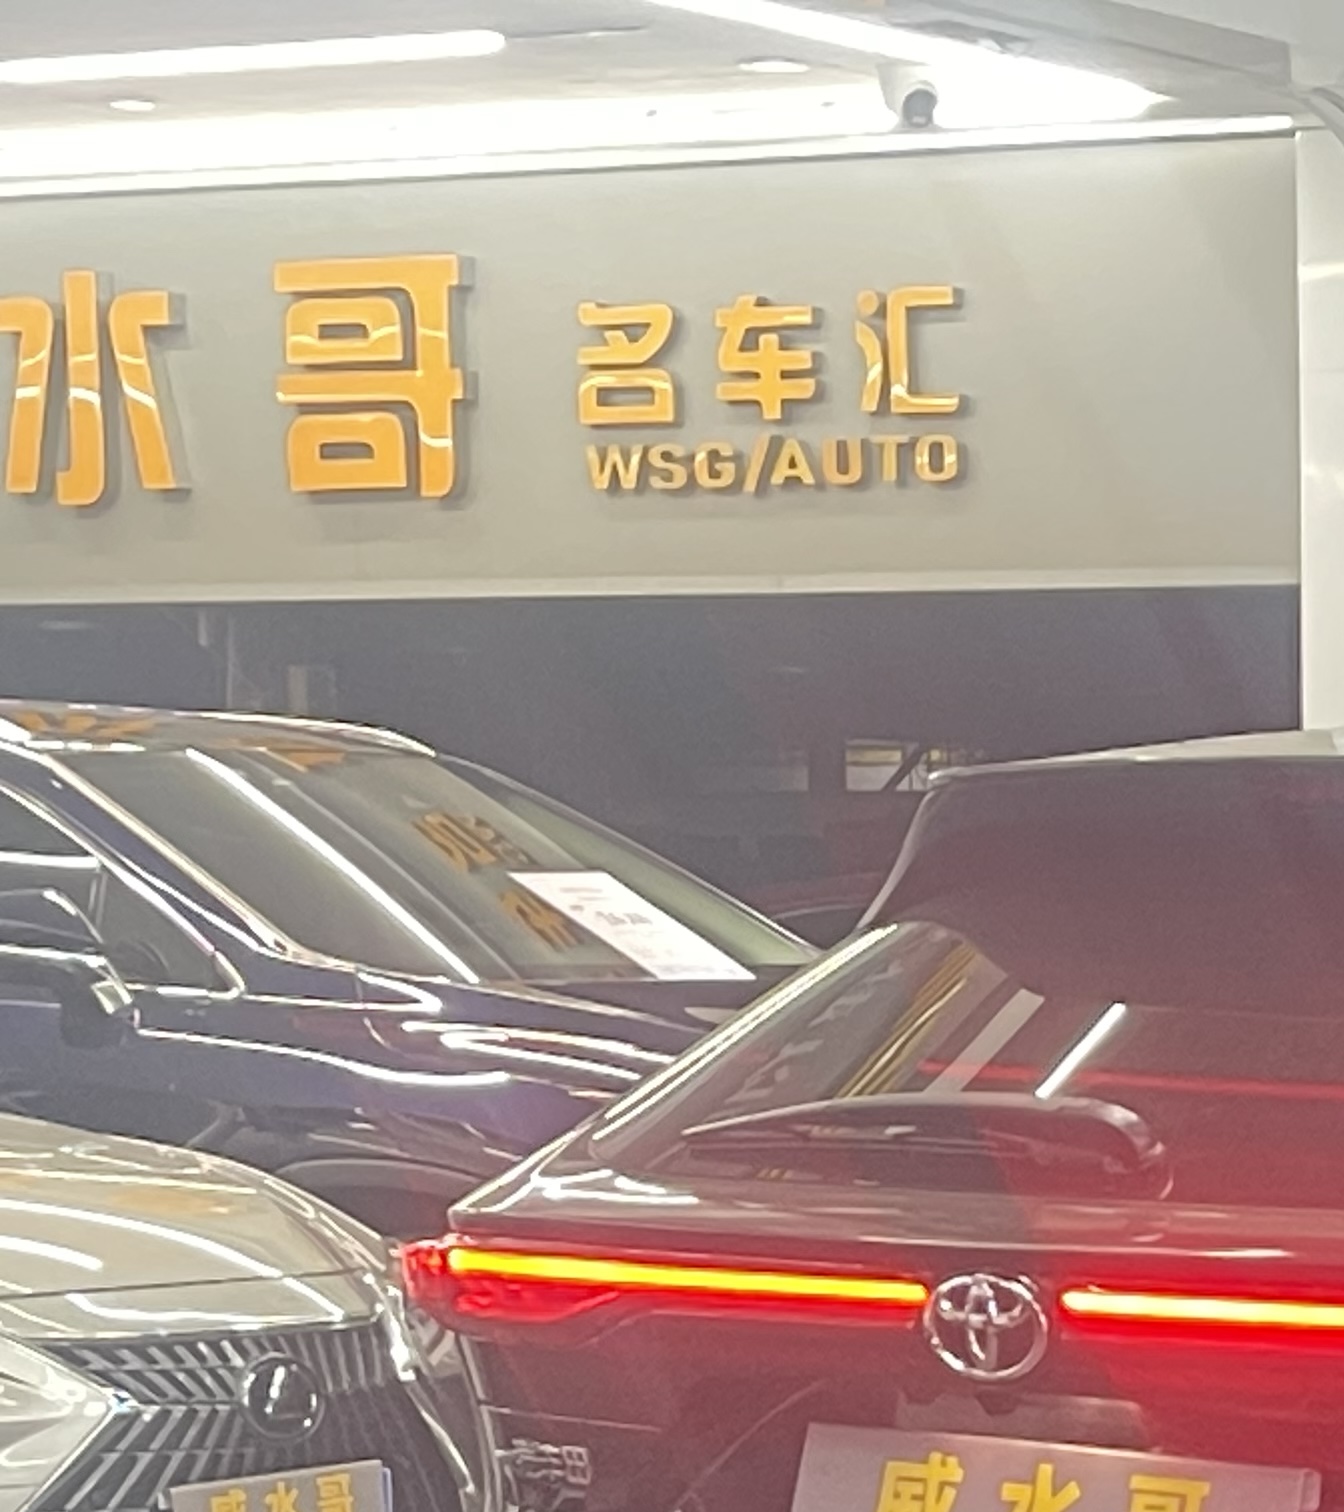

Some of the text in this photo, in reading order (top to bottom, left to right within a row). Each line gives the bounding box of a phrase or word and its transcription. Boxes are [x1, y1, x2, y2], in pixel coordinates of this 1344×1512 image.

[577, 285, 960, 426] 名车汇
[585, 433, 960, 494] WSG/AUTO
